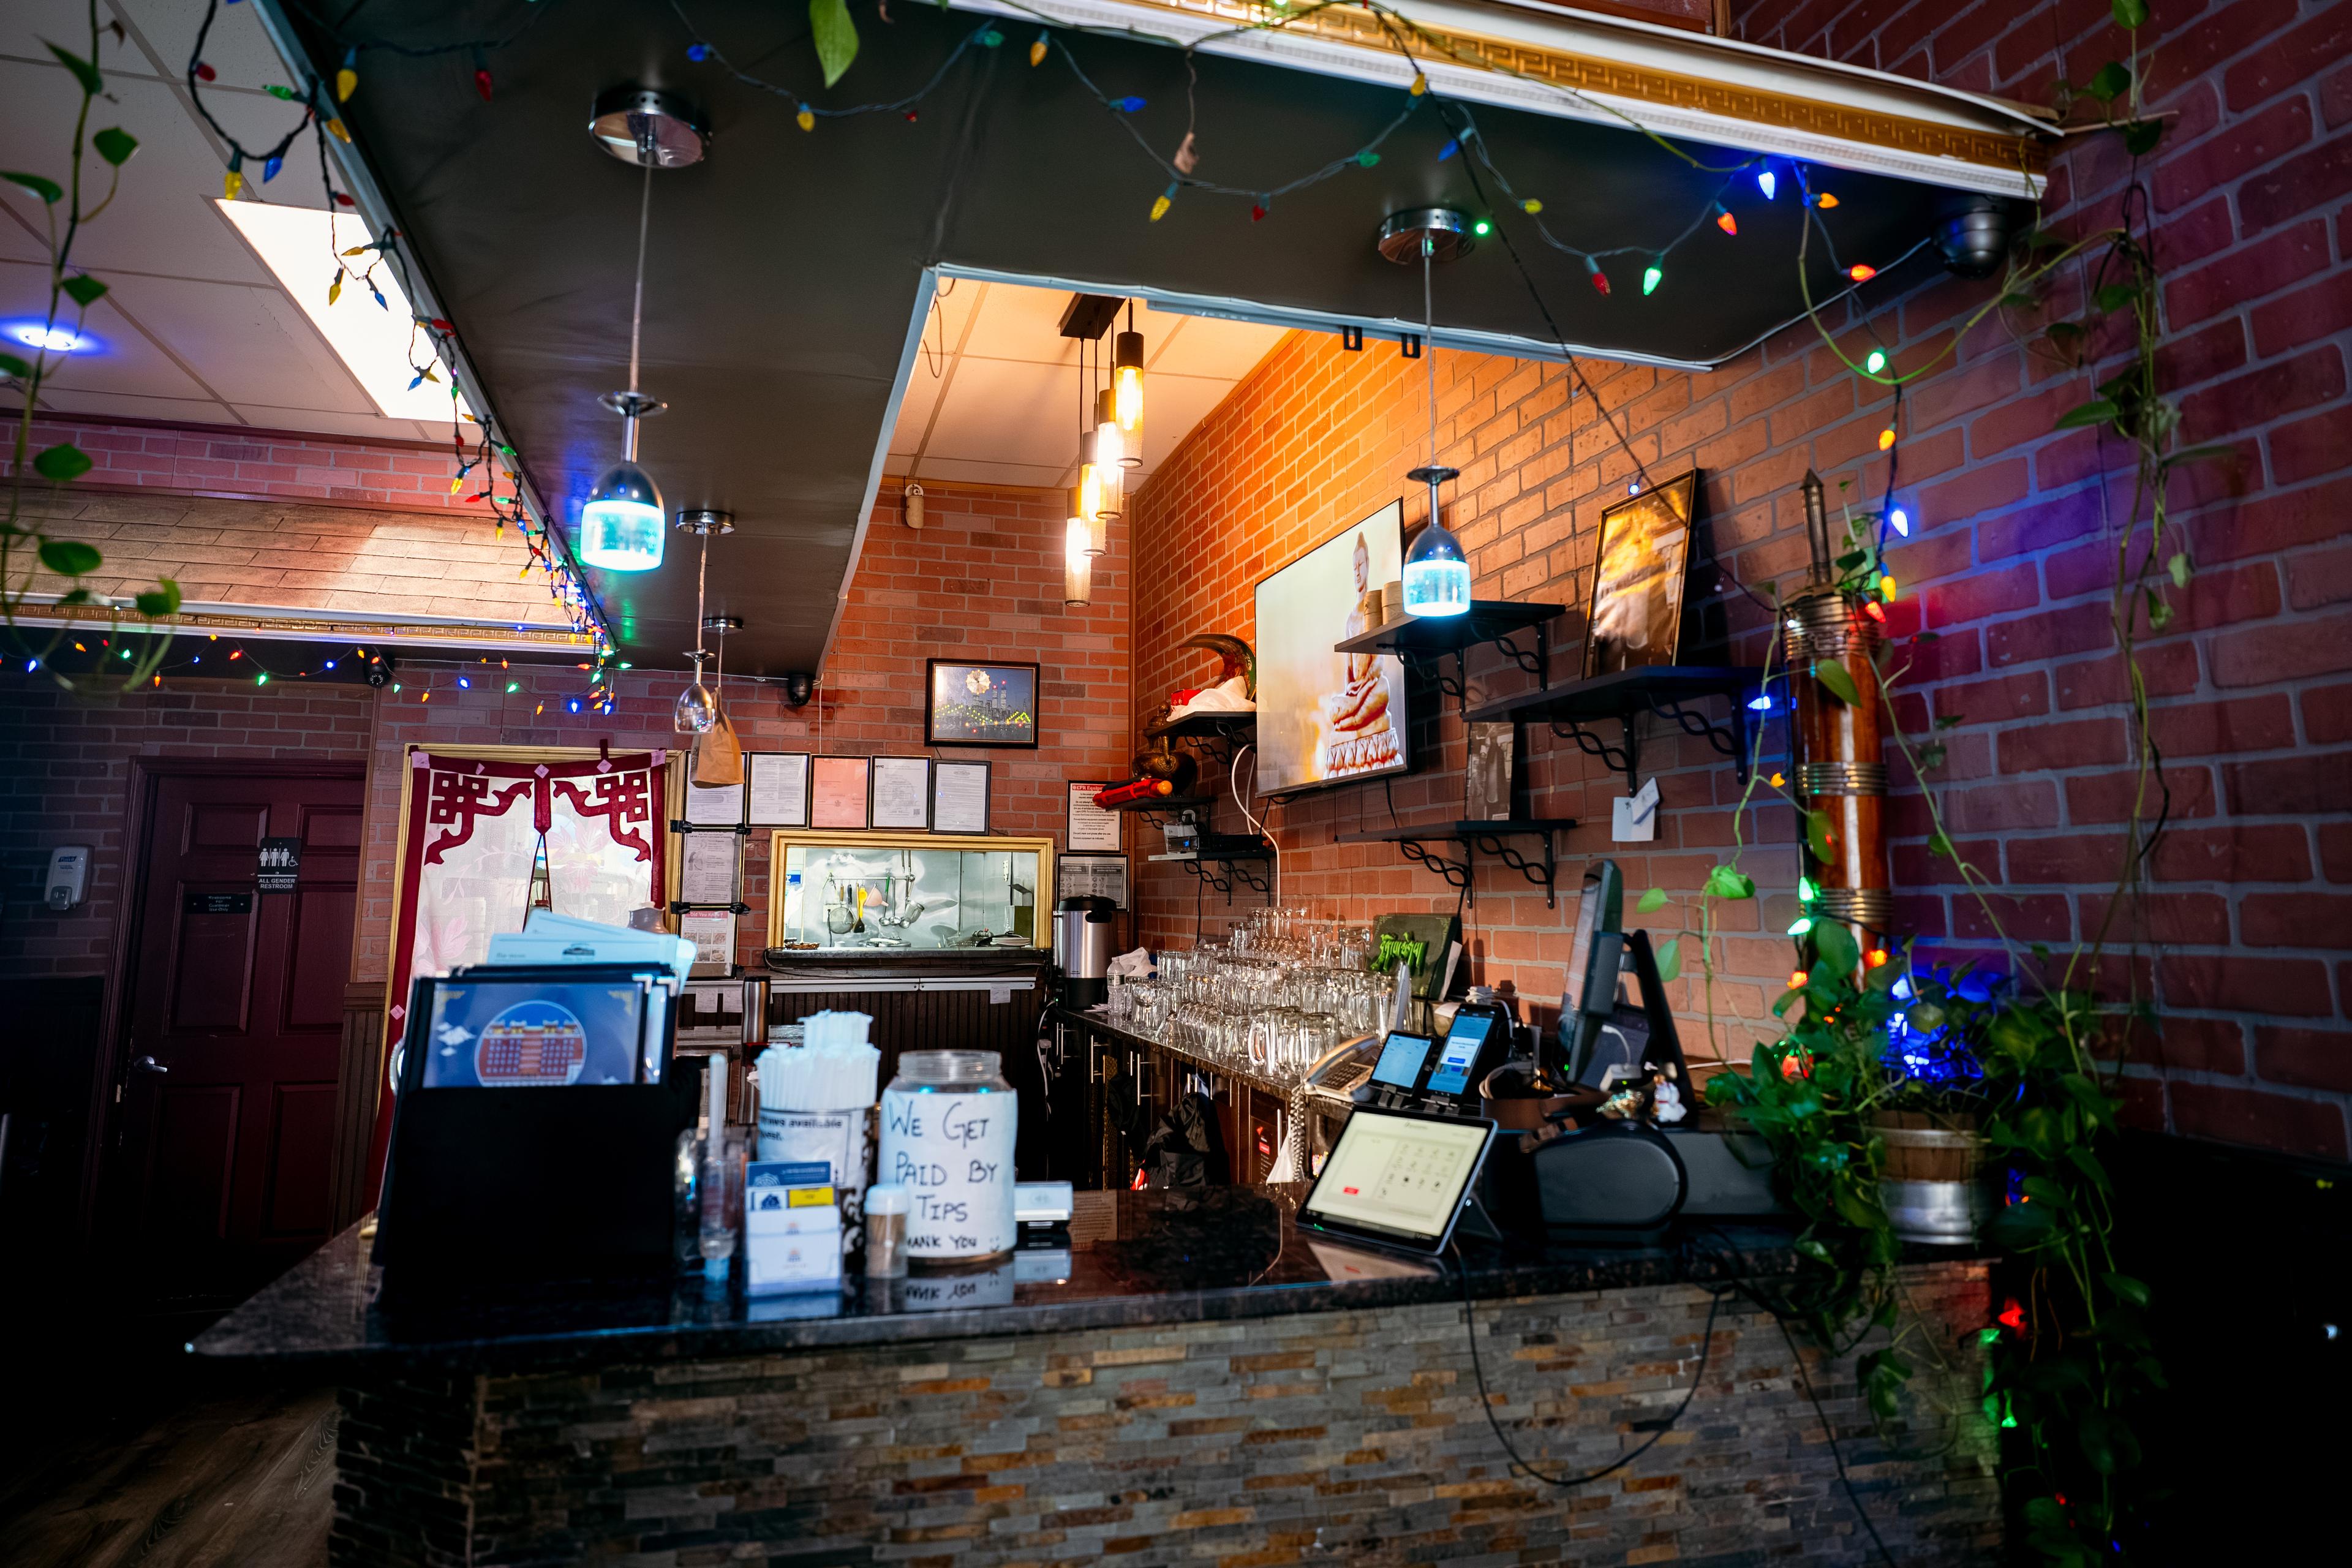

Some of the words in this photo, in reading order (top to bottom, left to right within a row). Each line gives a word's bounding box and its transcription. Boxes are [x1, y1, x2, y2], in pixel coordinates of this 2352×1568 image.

[889, 1101, 923, 1137] WE
[943, 1101, 989, 1150] GET
[895, 1151, 948, 1186] PAID
[967, 1159, 997, 1183] BY
[915, 1194, 968, 1223] TIPS
[949, 1235, 977, 1251] YOU
